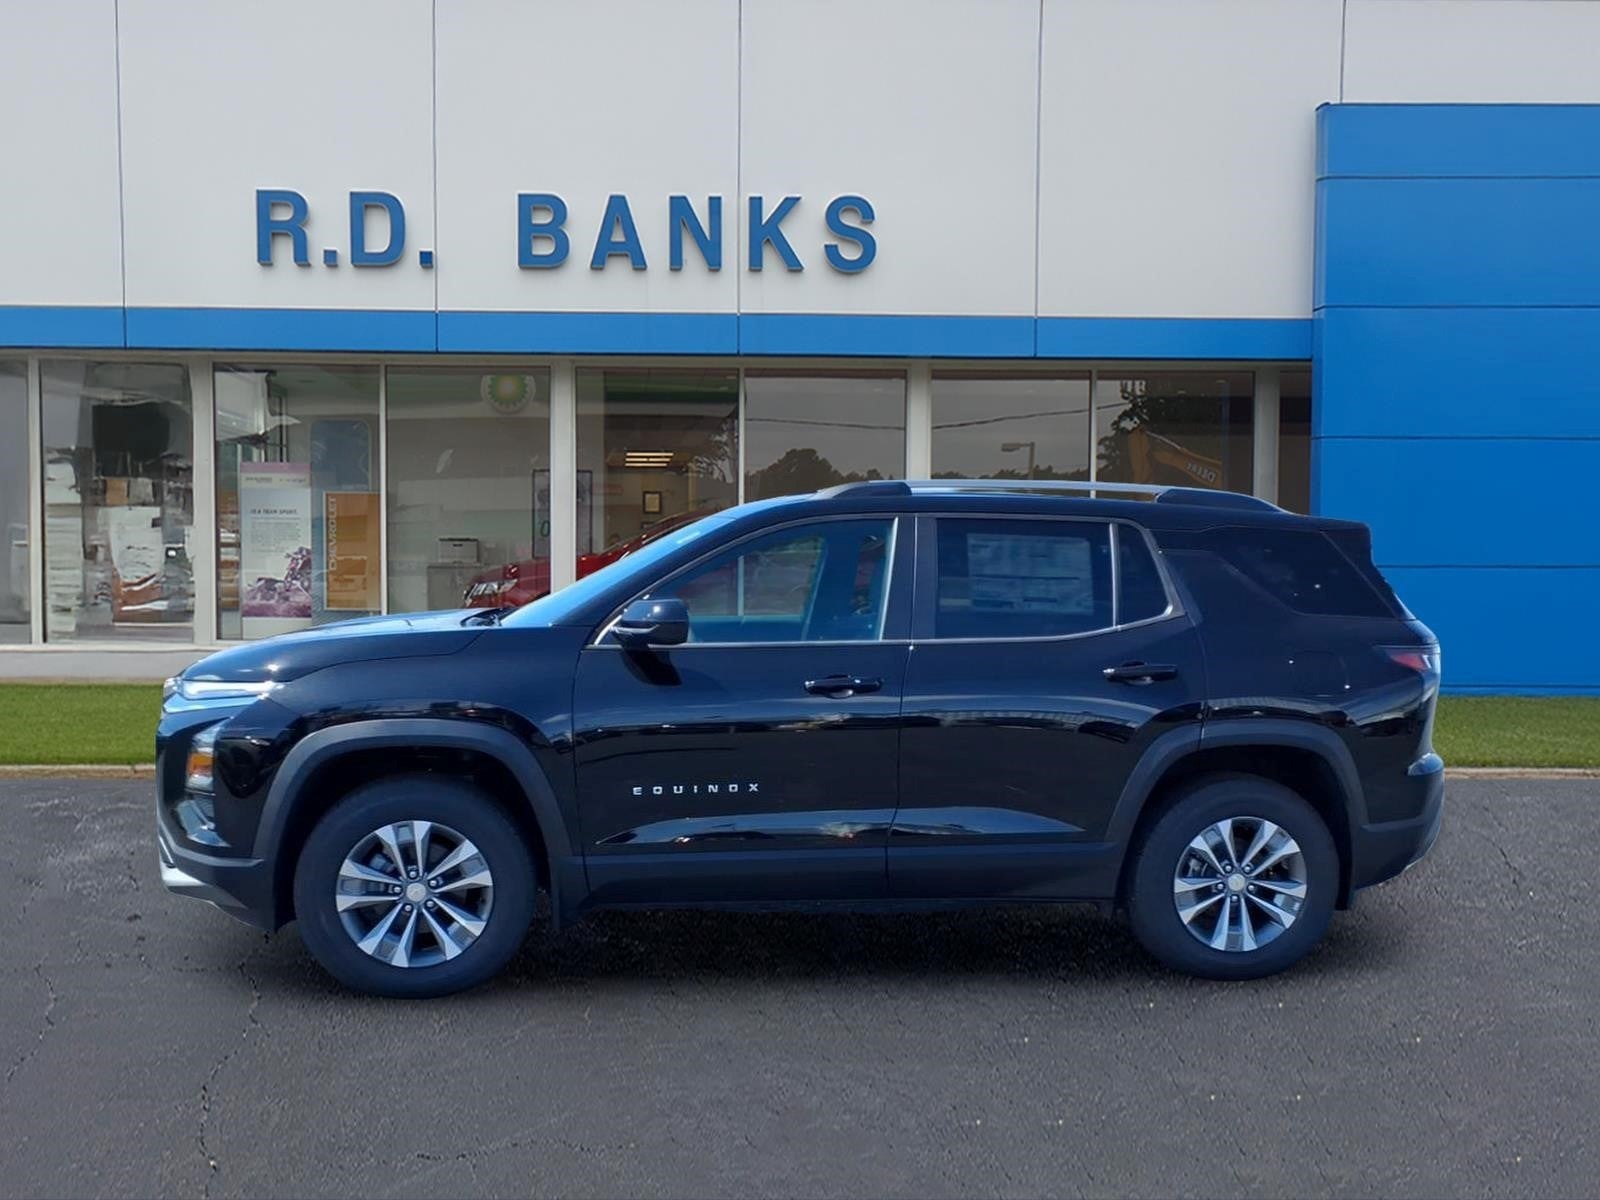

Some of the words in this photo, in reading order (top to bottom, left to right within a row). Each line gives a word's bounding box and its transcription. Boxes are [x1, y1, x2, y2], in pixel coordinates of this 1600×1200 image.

[256, 188, 434, 268] R.D.
[517, 192, 877, 274] BANKS
[632, 783, 759, 795] EQUINOX
